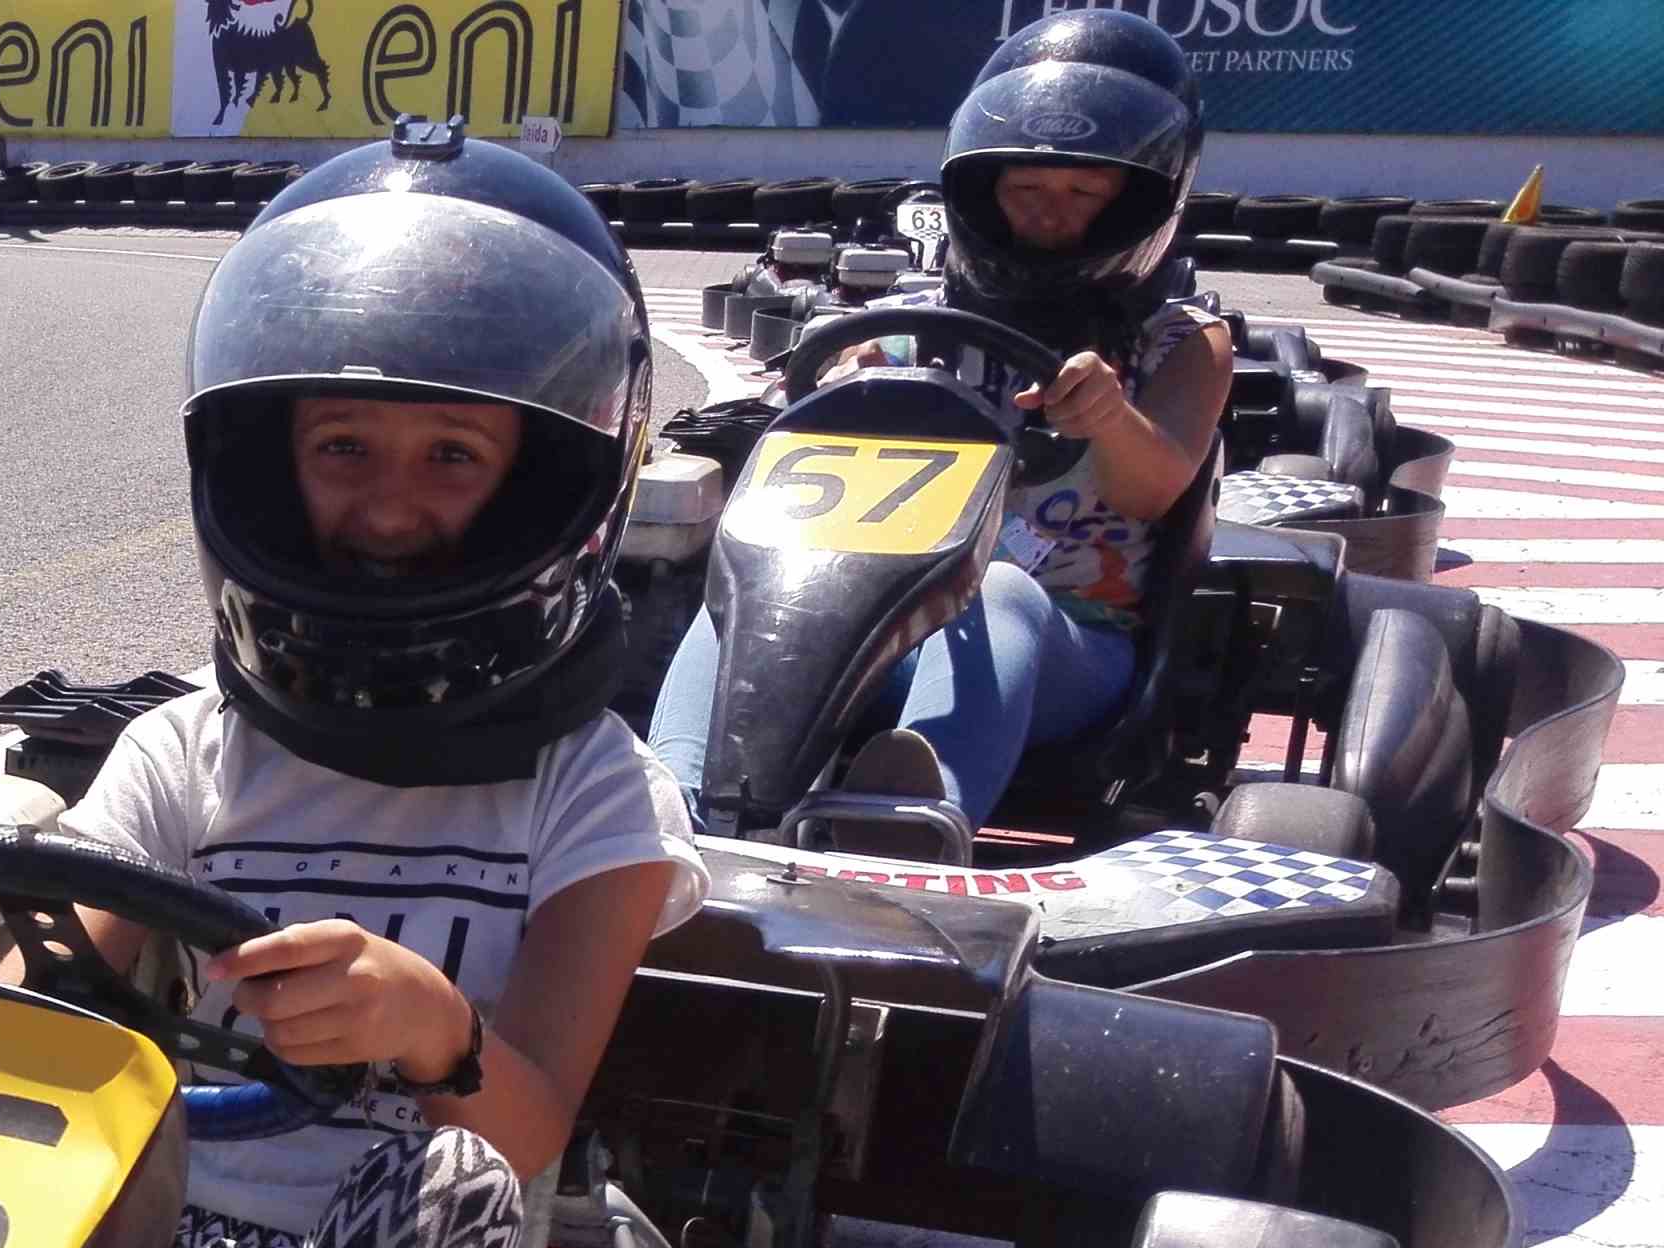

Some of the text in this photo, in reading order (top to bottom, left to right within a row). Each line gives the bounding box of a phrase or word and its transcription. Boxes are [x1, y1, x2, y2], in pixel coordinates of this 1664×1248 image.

[362, 0, 581, 126] eni
[1224, 50, 1354, 72] PARTNERS
[911, 210, 942, 231] 63
[763, 445, 959, 523] 67
[202, 858, 519, 885] NE OF A KIN
